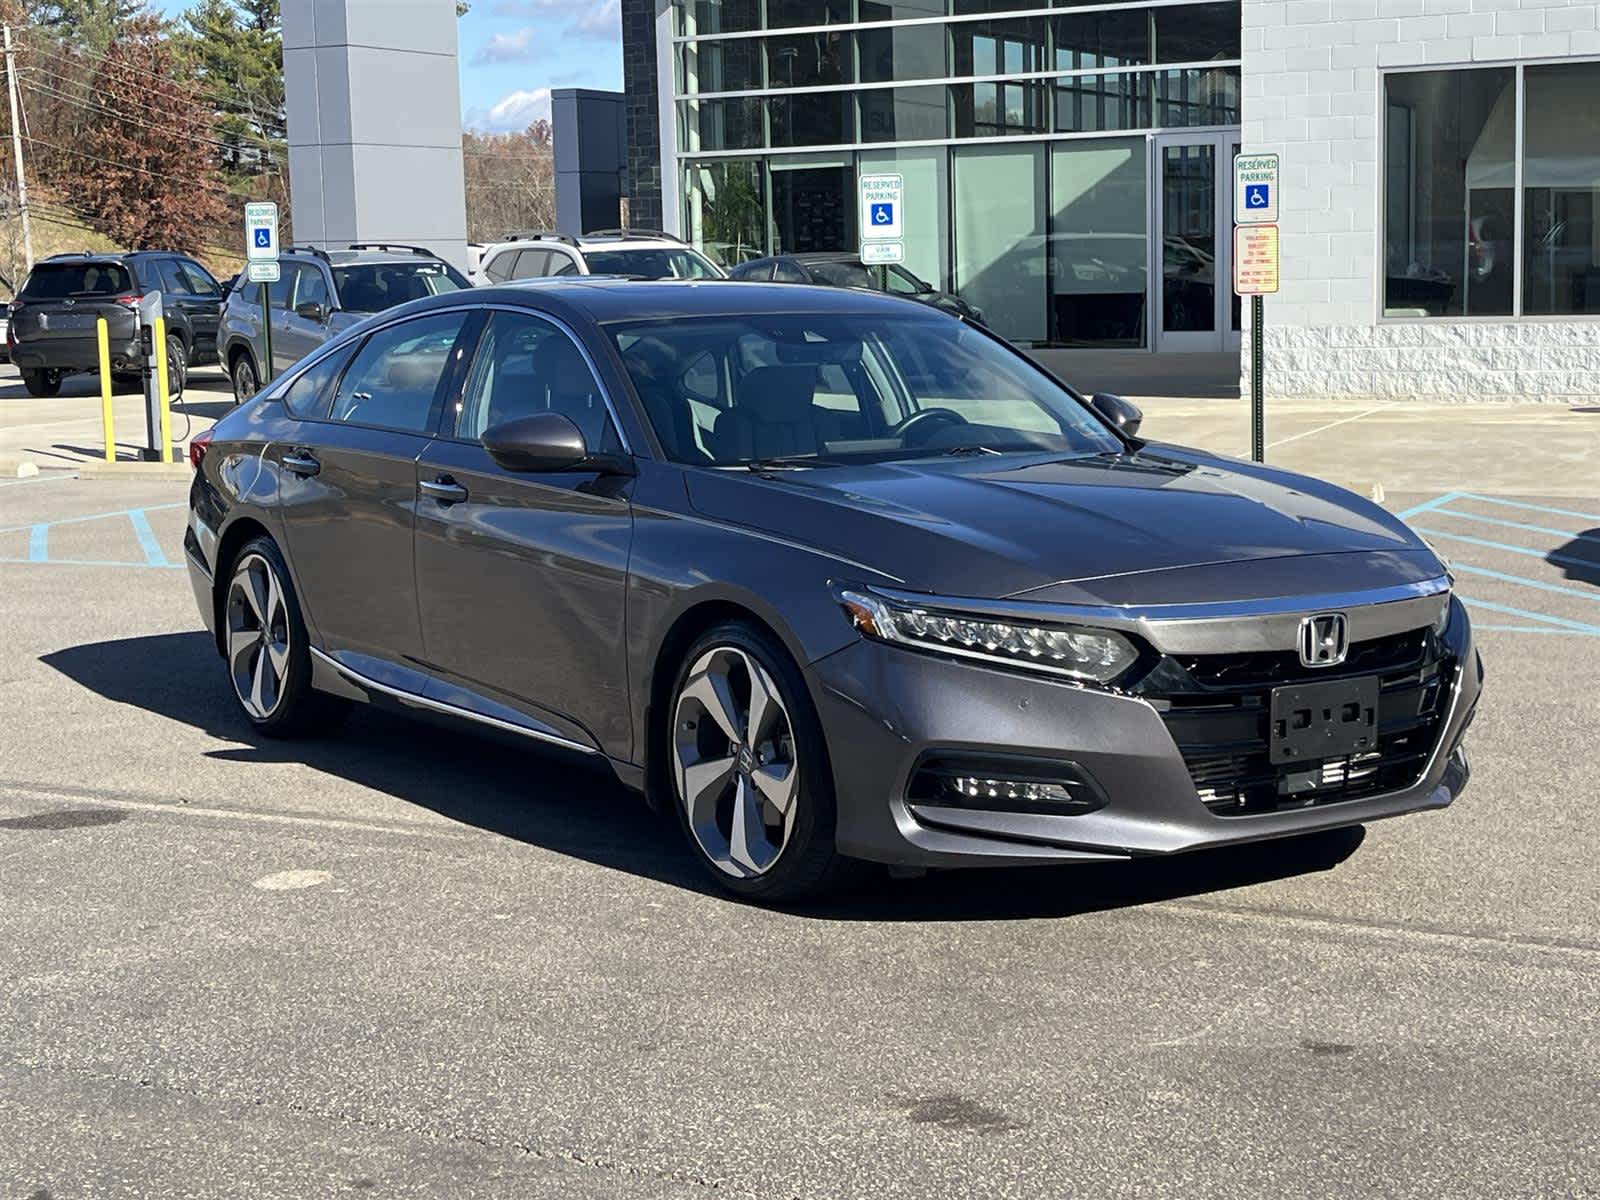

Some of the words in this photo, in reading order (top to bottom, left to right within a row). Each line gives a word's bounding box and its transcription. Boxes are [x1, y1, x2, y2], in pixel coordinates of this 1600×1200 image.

[1238, 159, 1276, 170] RESERVED
[1240, 172, 1274, 181] PARKING
[863, 180, 902, 190] RESERVED
[866, 192, 898, 200] PARKING
